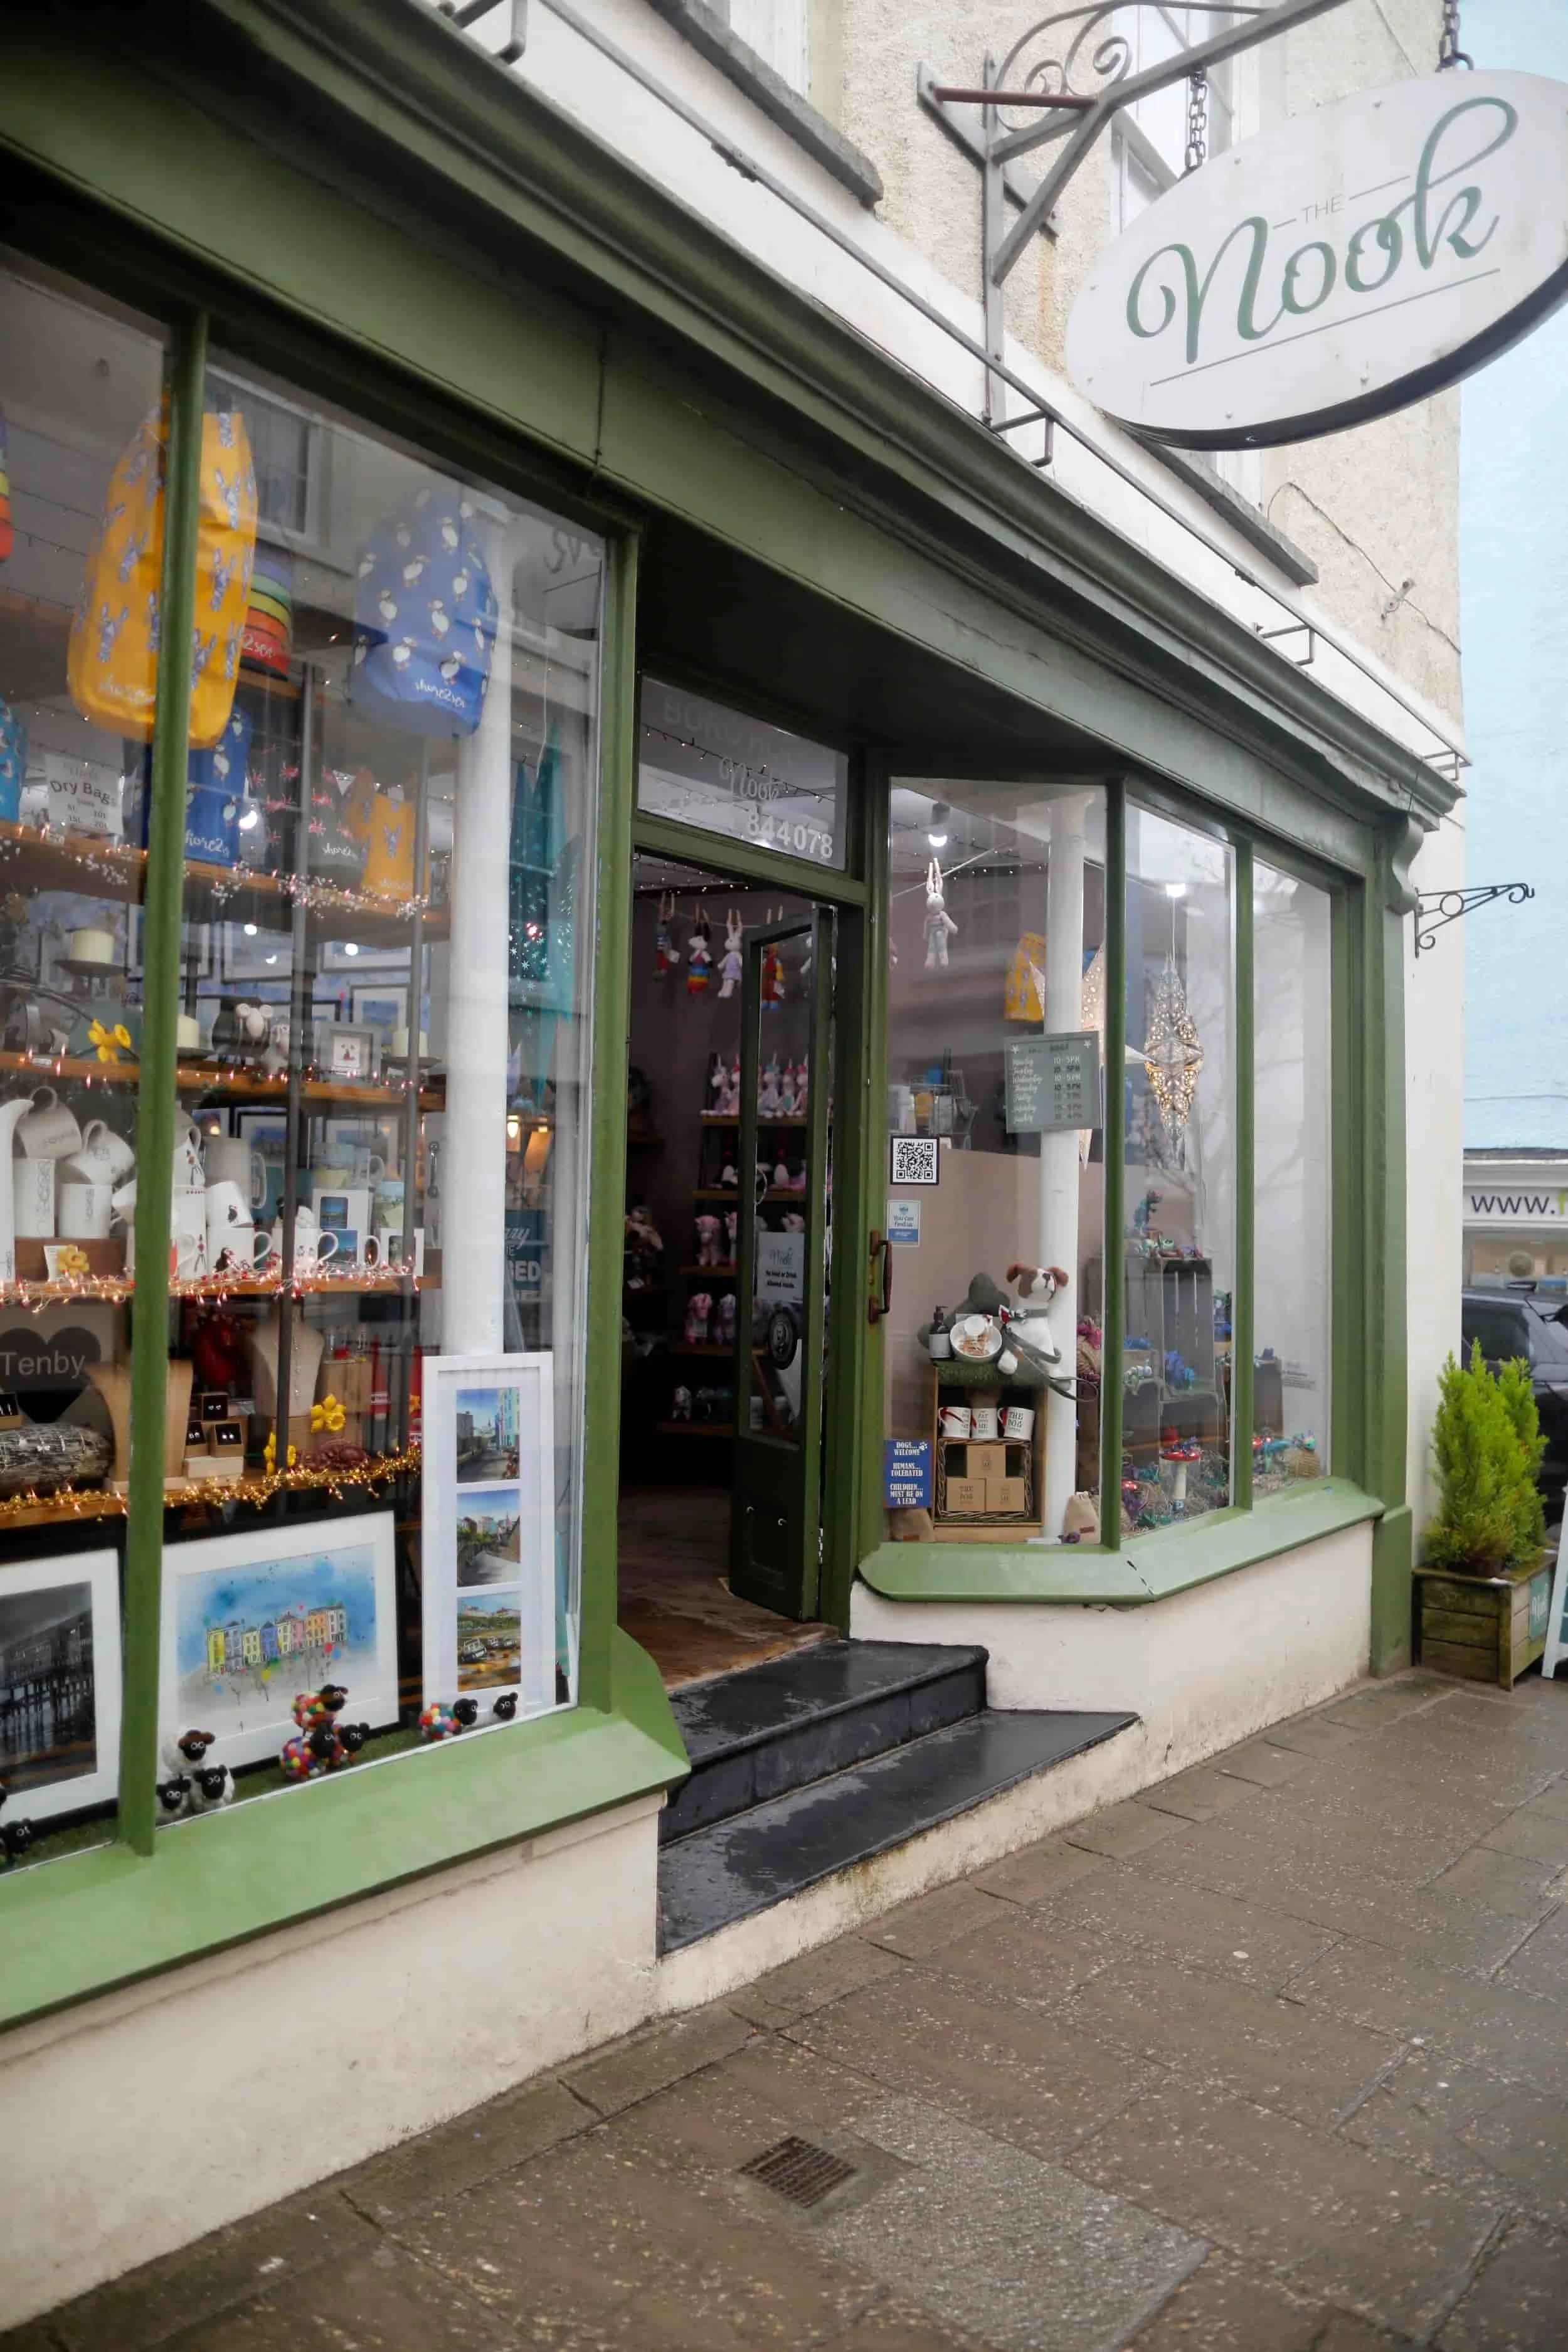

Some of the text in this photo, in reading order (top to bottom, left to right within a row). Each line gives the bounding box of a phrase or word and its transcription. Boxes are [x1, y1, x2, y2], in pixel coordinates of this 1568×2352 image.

[1302, 194, 1344, 222] THE
[1125, 96, 1519, 364] Nook
[50, 780, 78, 795] Dry
[745, 804, 834, 859] 844078
[0, 1350, 87, 1380] Tenby
